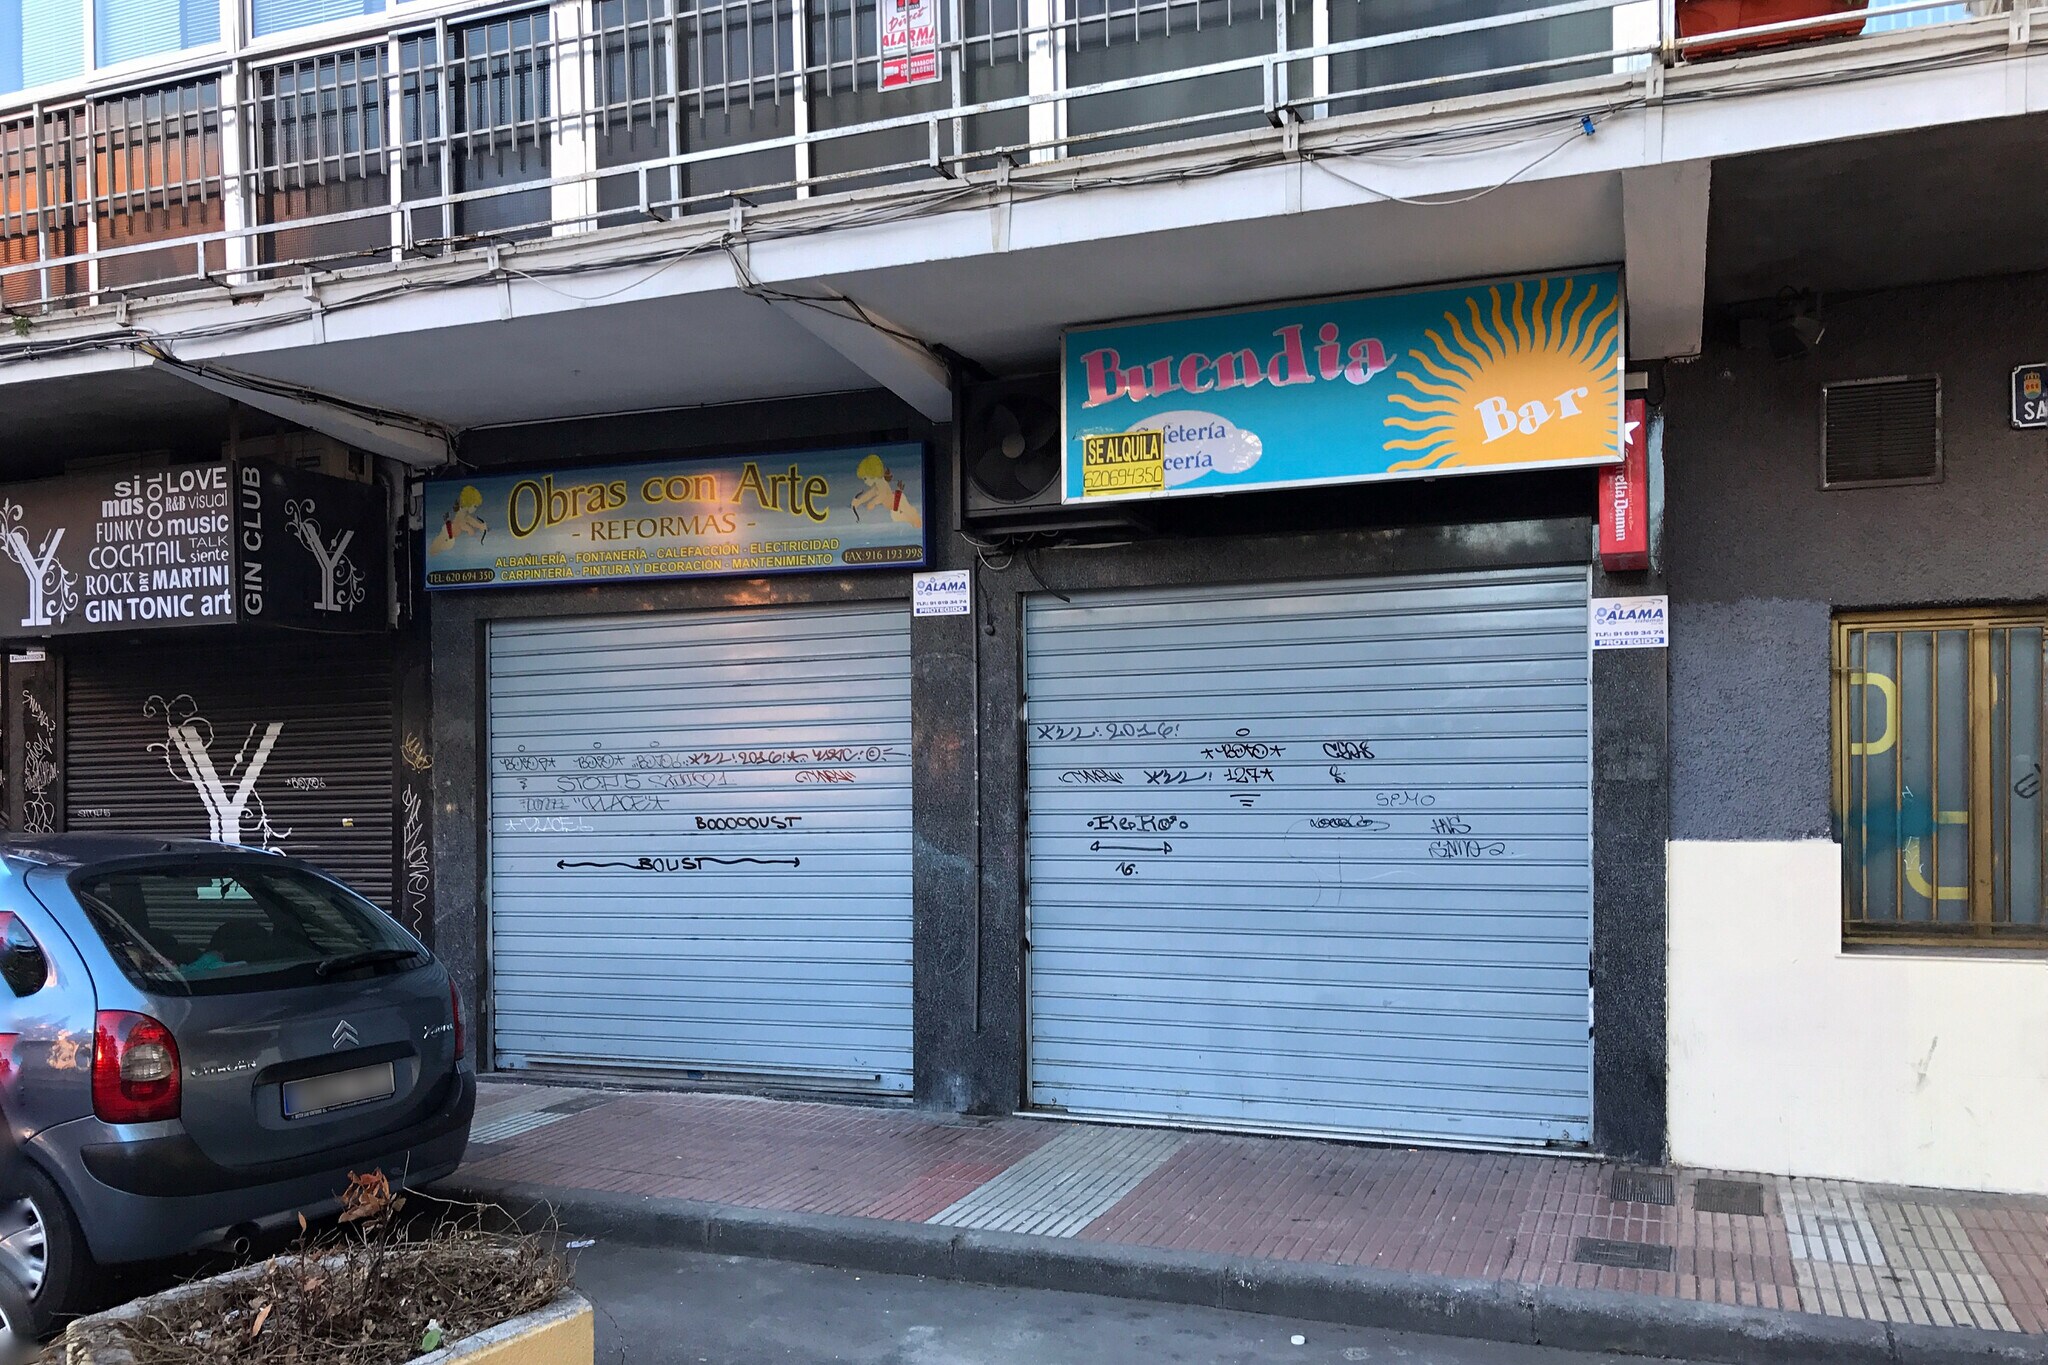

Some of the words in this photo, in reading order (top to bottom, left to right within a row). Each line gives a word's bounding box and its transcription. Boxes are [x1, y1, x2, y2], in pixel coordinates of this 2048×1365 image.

[1474, 387, 1588, 445] Bar
[1088, 437, 1104, 464] SE
[1106, 434, 1160, 464] ALQUILA
[114, 475, 141, 498] si
[166, 466, 227, 494] LOVE
[102, 497, 144, 518] mas
[146, 472, 163, 538] COOL
[166, 496, 186, 512] R&B
[188, 490, 228, 510] visual
[242, 466, 263, 551] CLUB
[508, 474, 627, 540] Obras
[641, 473, 718, 504] con
[730, 461, 829, 524] Arte
[96, 518, 144, 544] FUNKY
[167, 510, 229, 536] music
[590, 512, 737, 542] REFORMAS
[1614, 498, 1628, 541] Damm
[188, 535, 229, 548] TALK
[750, 538, 840, 554] ELECTRICIDAD
[866, 550, 883, 560] 916
[886, 549, 902, 560] 193
[906, 548, 922, 558] 998
[88, 540, 186, 570] COCKTAIL
[190, 548, 229, 564] siente
[582, 564, 632, 577] PINTURA
[633, 564, 641, 575] Y
[732, 554, 833, 570] MANTENIMIENTO
[85, 572, 135, 596] ROCK
[138, 572, 150, 592] DRY
[152, 565, 229, 591] MARTINI
[244, 562, 263, 616] GIN
[446, 572, 460, 582] 620
[479, 570, 494, 580] 350
[924, 581, 966, 592] ALAMA
[85, 599, 123, 623] GIN
[126, 594, 194, 620] TONIC
[200, 588, 232, 616] art
[1606, 608, 1664, 620] ALAMA
[1599, 637, 1661, 646] PROTEGIDO
